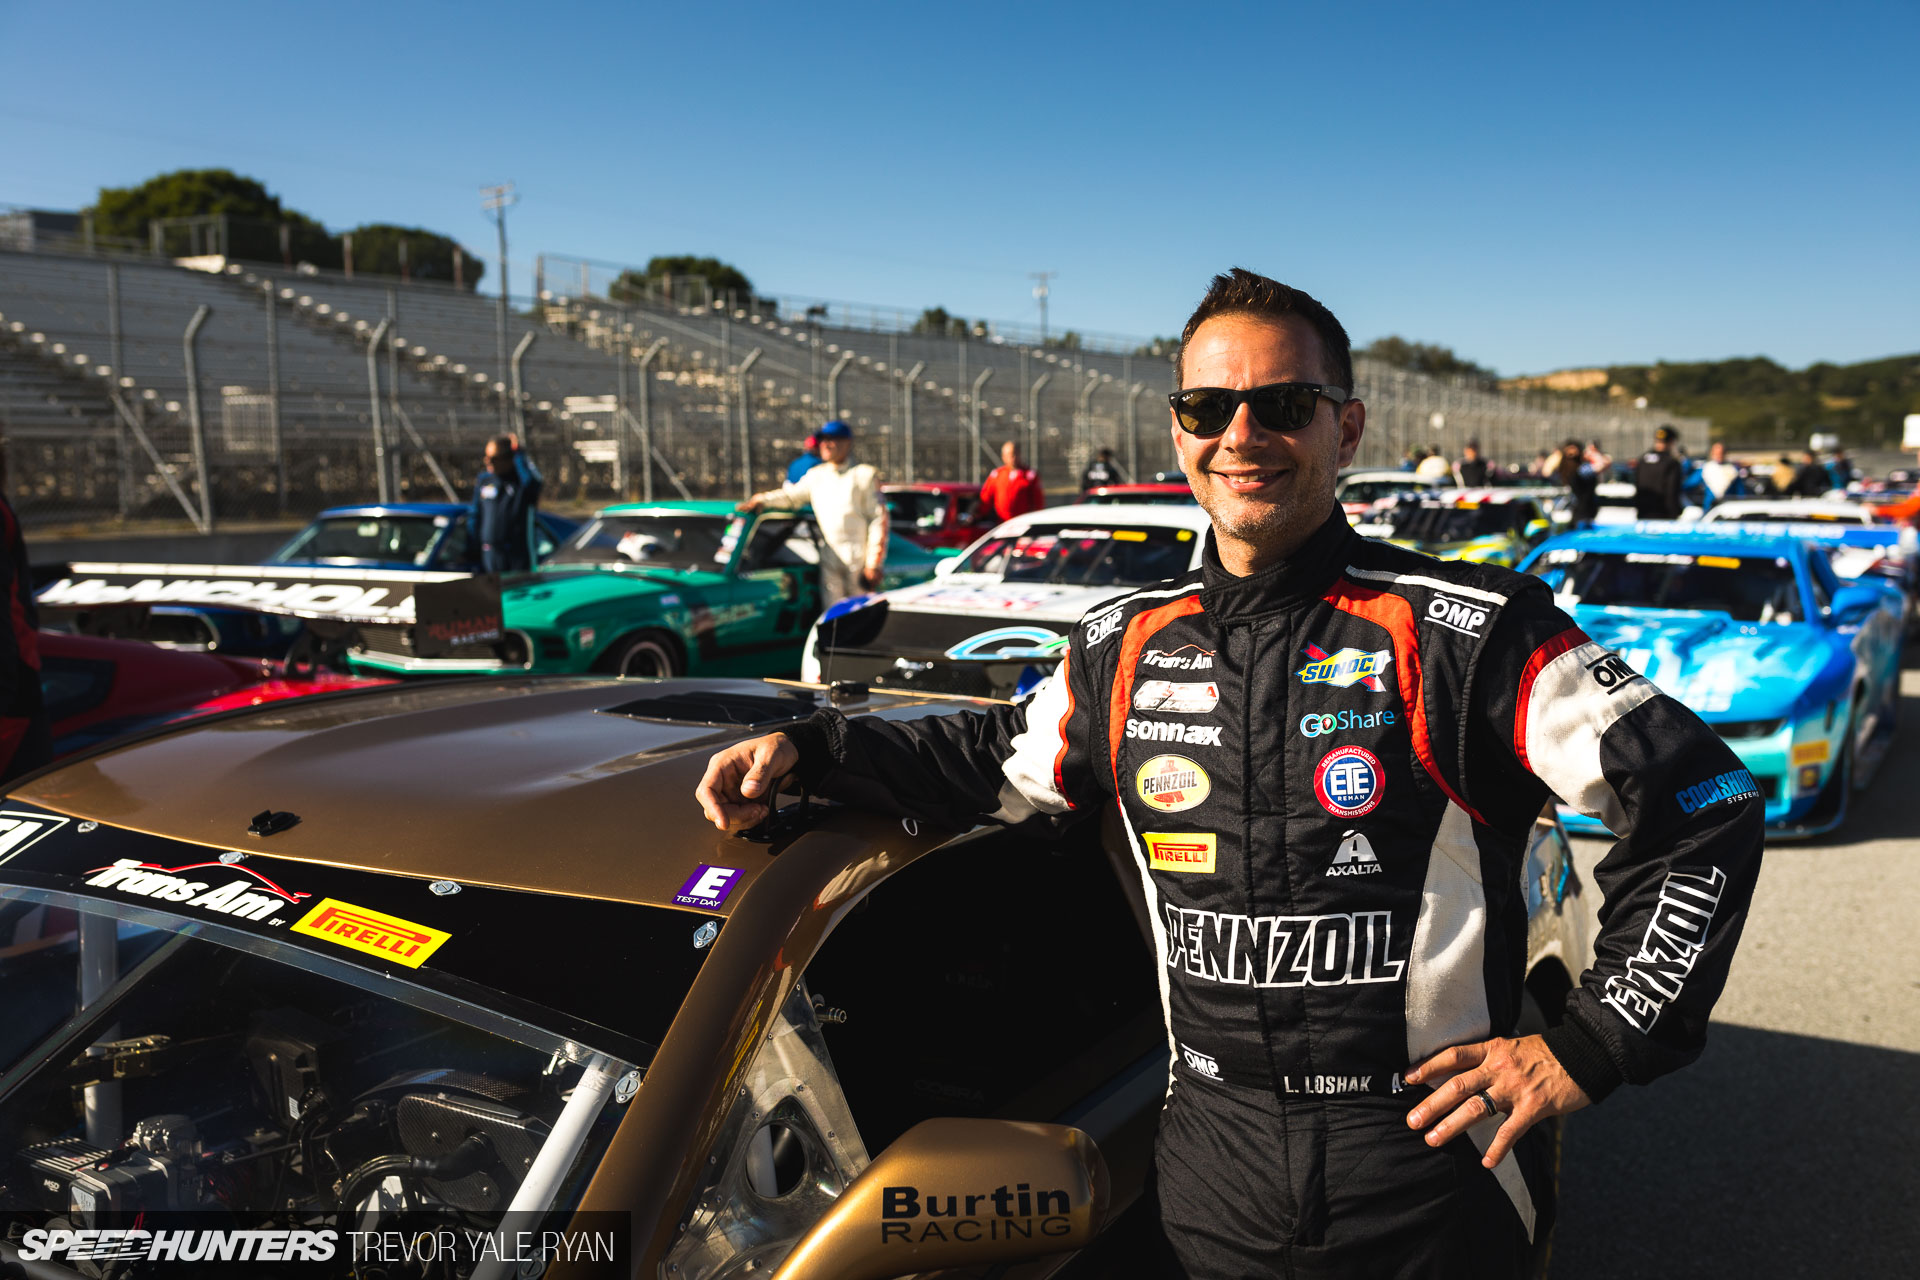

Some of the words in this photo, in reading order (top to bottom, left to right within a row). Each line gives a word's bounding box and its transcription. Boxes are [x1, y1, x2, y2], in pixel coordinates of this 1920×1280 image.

[1086, 611, 1123, 643] OMP
[1428, 599, 1486, 630] OMP
[1189, 653, 1213, 670] Am
[1593, 657, 1636, 687] OM
[1126, 718, 1222, 746] sonnax
[1321, 747, 1376, 768] REMANUFACTURED
[1143, 771, 1197, 795] PENNZOIL
[1330, 762, 1370, 796] ETE
[1327, 800, 1376, 816] TRANSMISSIONS
[1337, 794, 1365, 802] REMAN
[1152, 842, 1208, 863] PIRELLI
[689, 866, 736, 899] E
[1325, 863, 1382, 877] AXALTA
[85, 858, 200, 903] Trans
[195, 880, 285, 921] Am
[268, 917, 286, 928] BY
[676, 895, 699, 904] TEST
[699, 898, 720, 907] DAY
[309, 906, 432, 958] PIRELLI
[1165, 902, 1405, 988] PENNZOIL
[1184, 1050, 1220, 1076] OMP
[1284, 1075, 1300, 1093] L.
[1304, 1074, 1372, 1094] LOSHAK
[883, 1183, 1071, 1219] Burtin
[882, 1216, 1071, 1244] RACING
